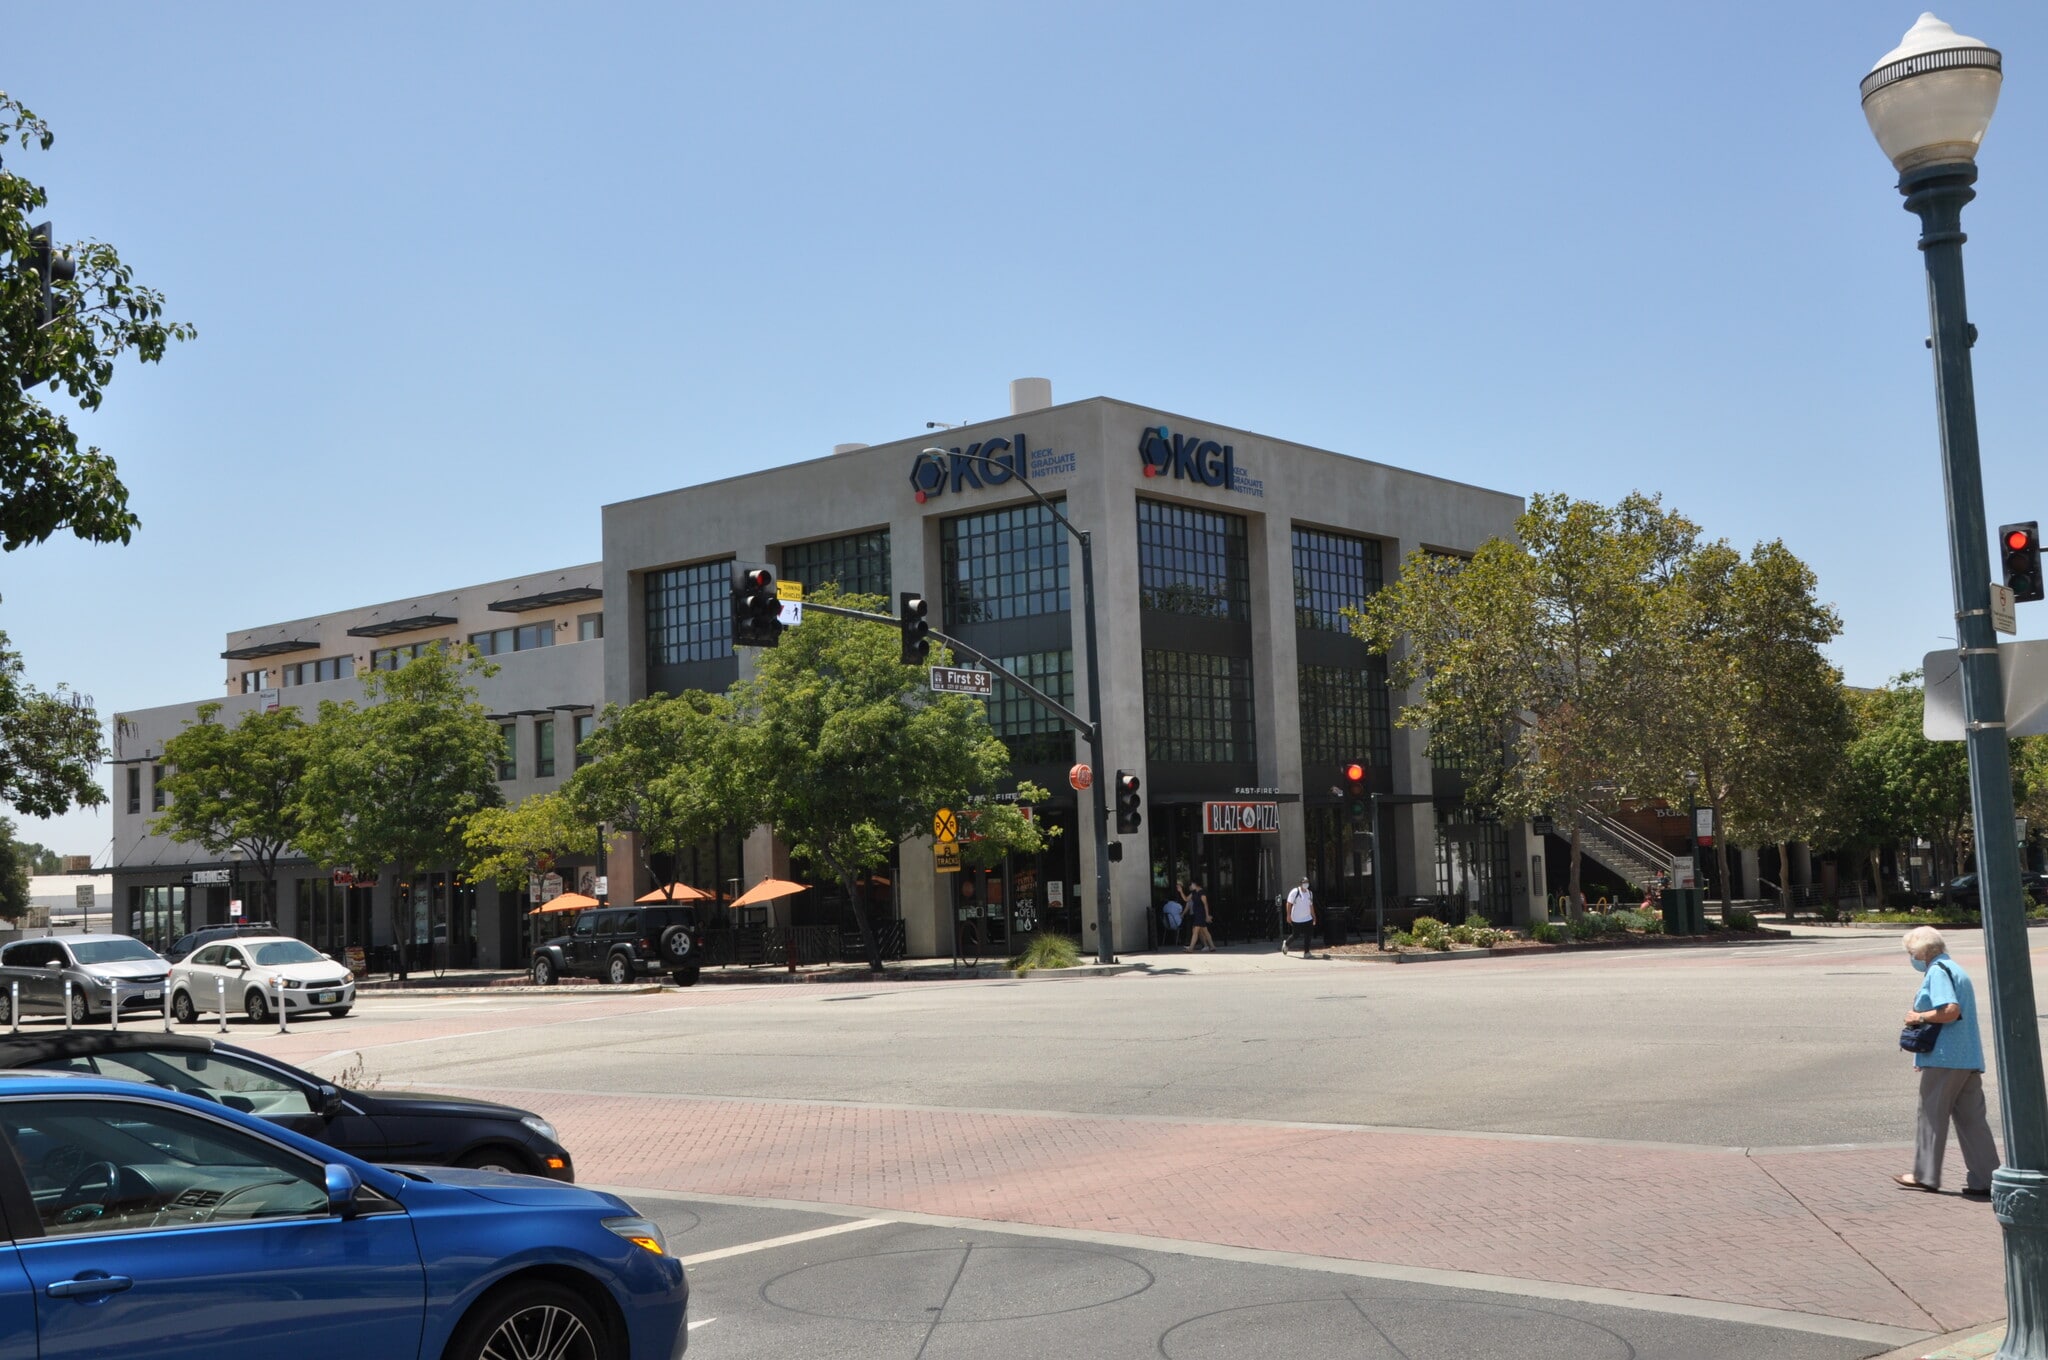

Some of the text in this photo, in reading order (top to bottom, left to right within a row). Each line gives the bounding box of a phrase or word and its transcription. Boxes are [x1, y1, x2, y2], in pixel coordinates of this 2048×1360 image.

[1031, 448, 1053, 460] KECK
[1031, 453, 1076, 469] GRADUATE
[951, 433, 1028, 493] KGI
[1173, 434, 1234, 490] KGI
[1031, 462, 1077, 479] INSTITUTE
[947, 671, 985, 686] First St
[1213, 804, 1280, 831] BLAZE PIZZA
[944, 846, 951, 857] 2
[937, 856, 960, 866] TRACKS
[1020, 907, 1036, 918] OPEN
